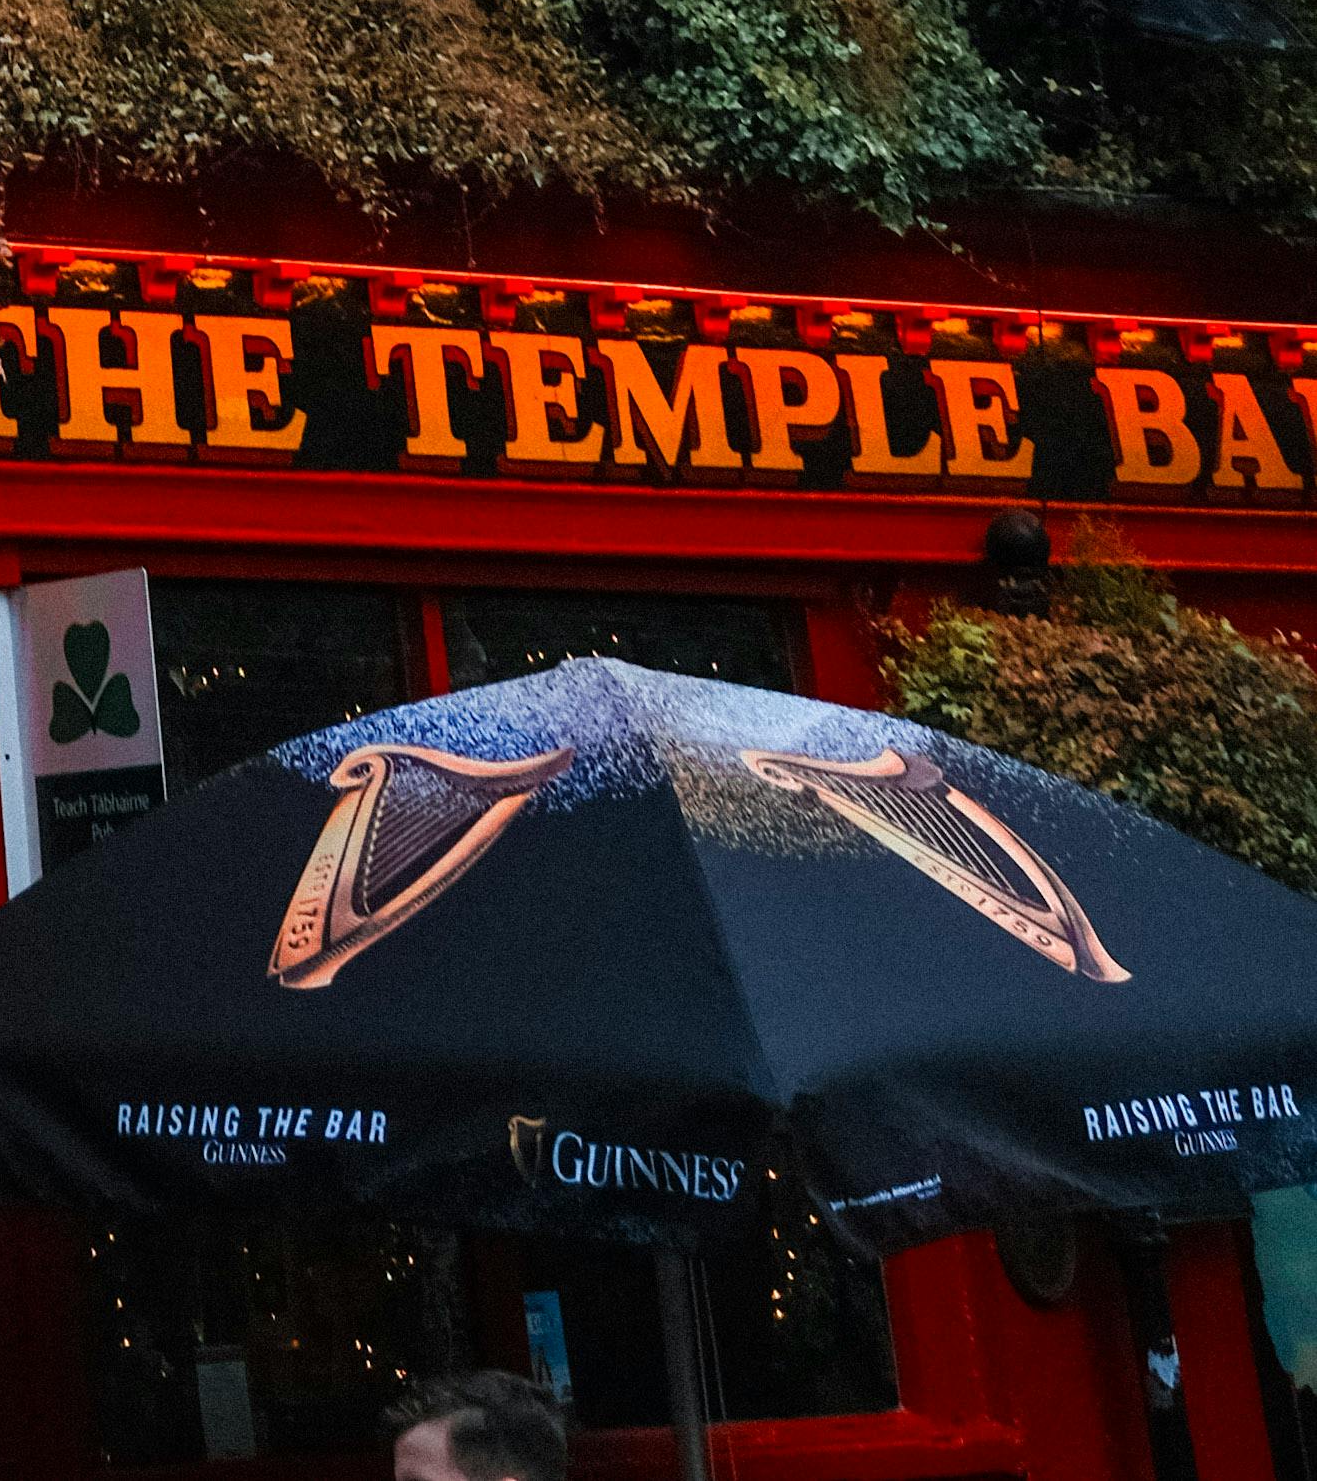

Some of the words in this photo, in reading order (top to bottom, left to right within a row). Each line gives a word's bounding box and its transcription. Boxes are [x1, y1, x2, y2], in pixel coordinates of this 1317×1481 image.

[365, 324, 1035, 480] TEMPLE
[1094, 367, 1317, 490] BA
[52, 793, 88, 820] Teach
[286, 896, 321, 951] 1759
[977, 896, 1054, 949] 1759
[116, 1102, 240, 1138] RAISING
[257, 1105, 312, 1140] THE
[324, 1107, 389, 1145] BAR
[1083, 1094, 1197, 1142] RAISING
[1199, 1088, 1243, 1124] THE
[1250, 1083, 1302, 1121] BAR
[202, 1138, 288, 1166] GUINNESS
[552, 1129, 747, 1202] GUINNESS
[1174, 1127, 1240, 1159] GUINNESS
